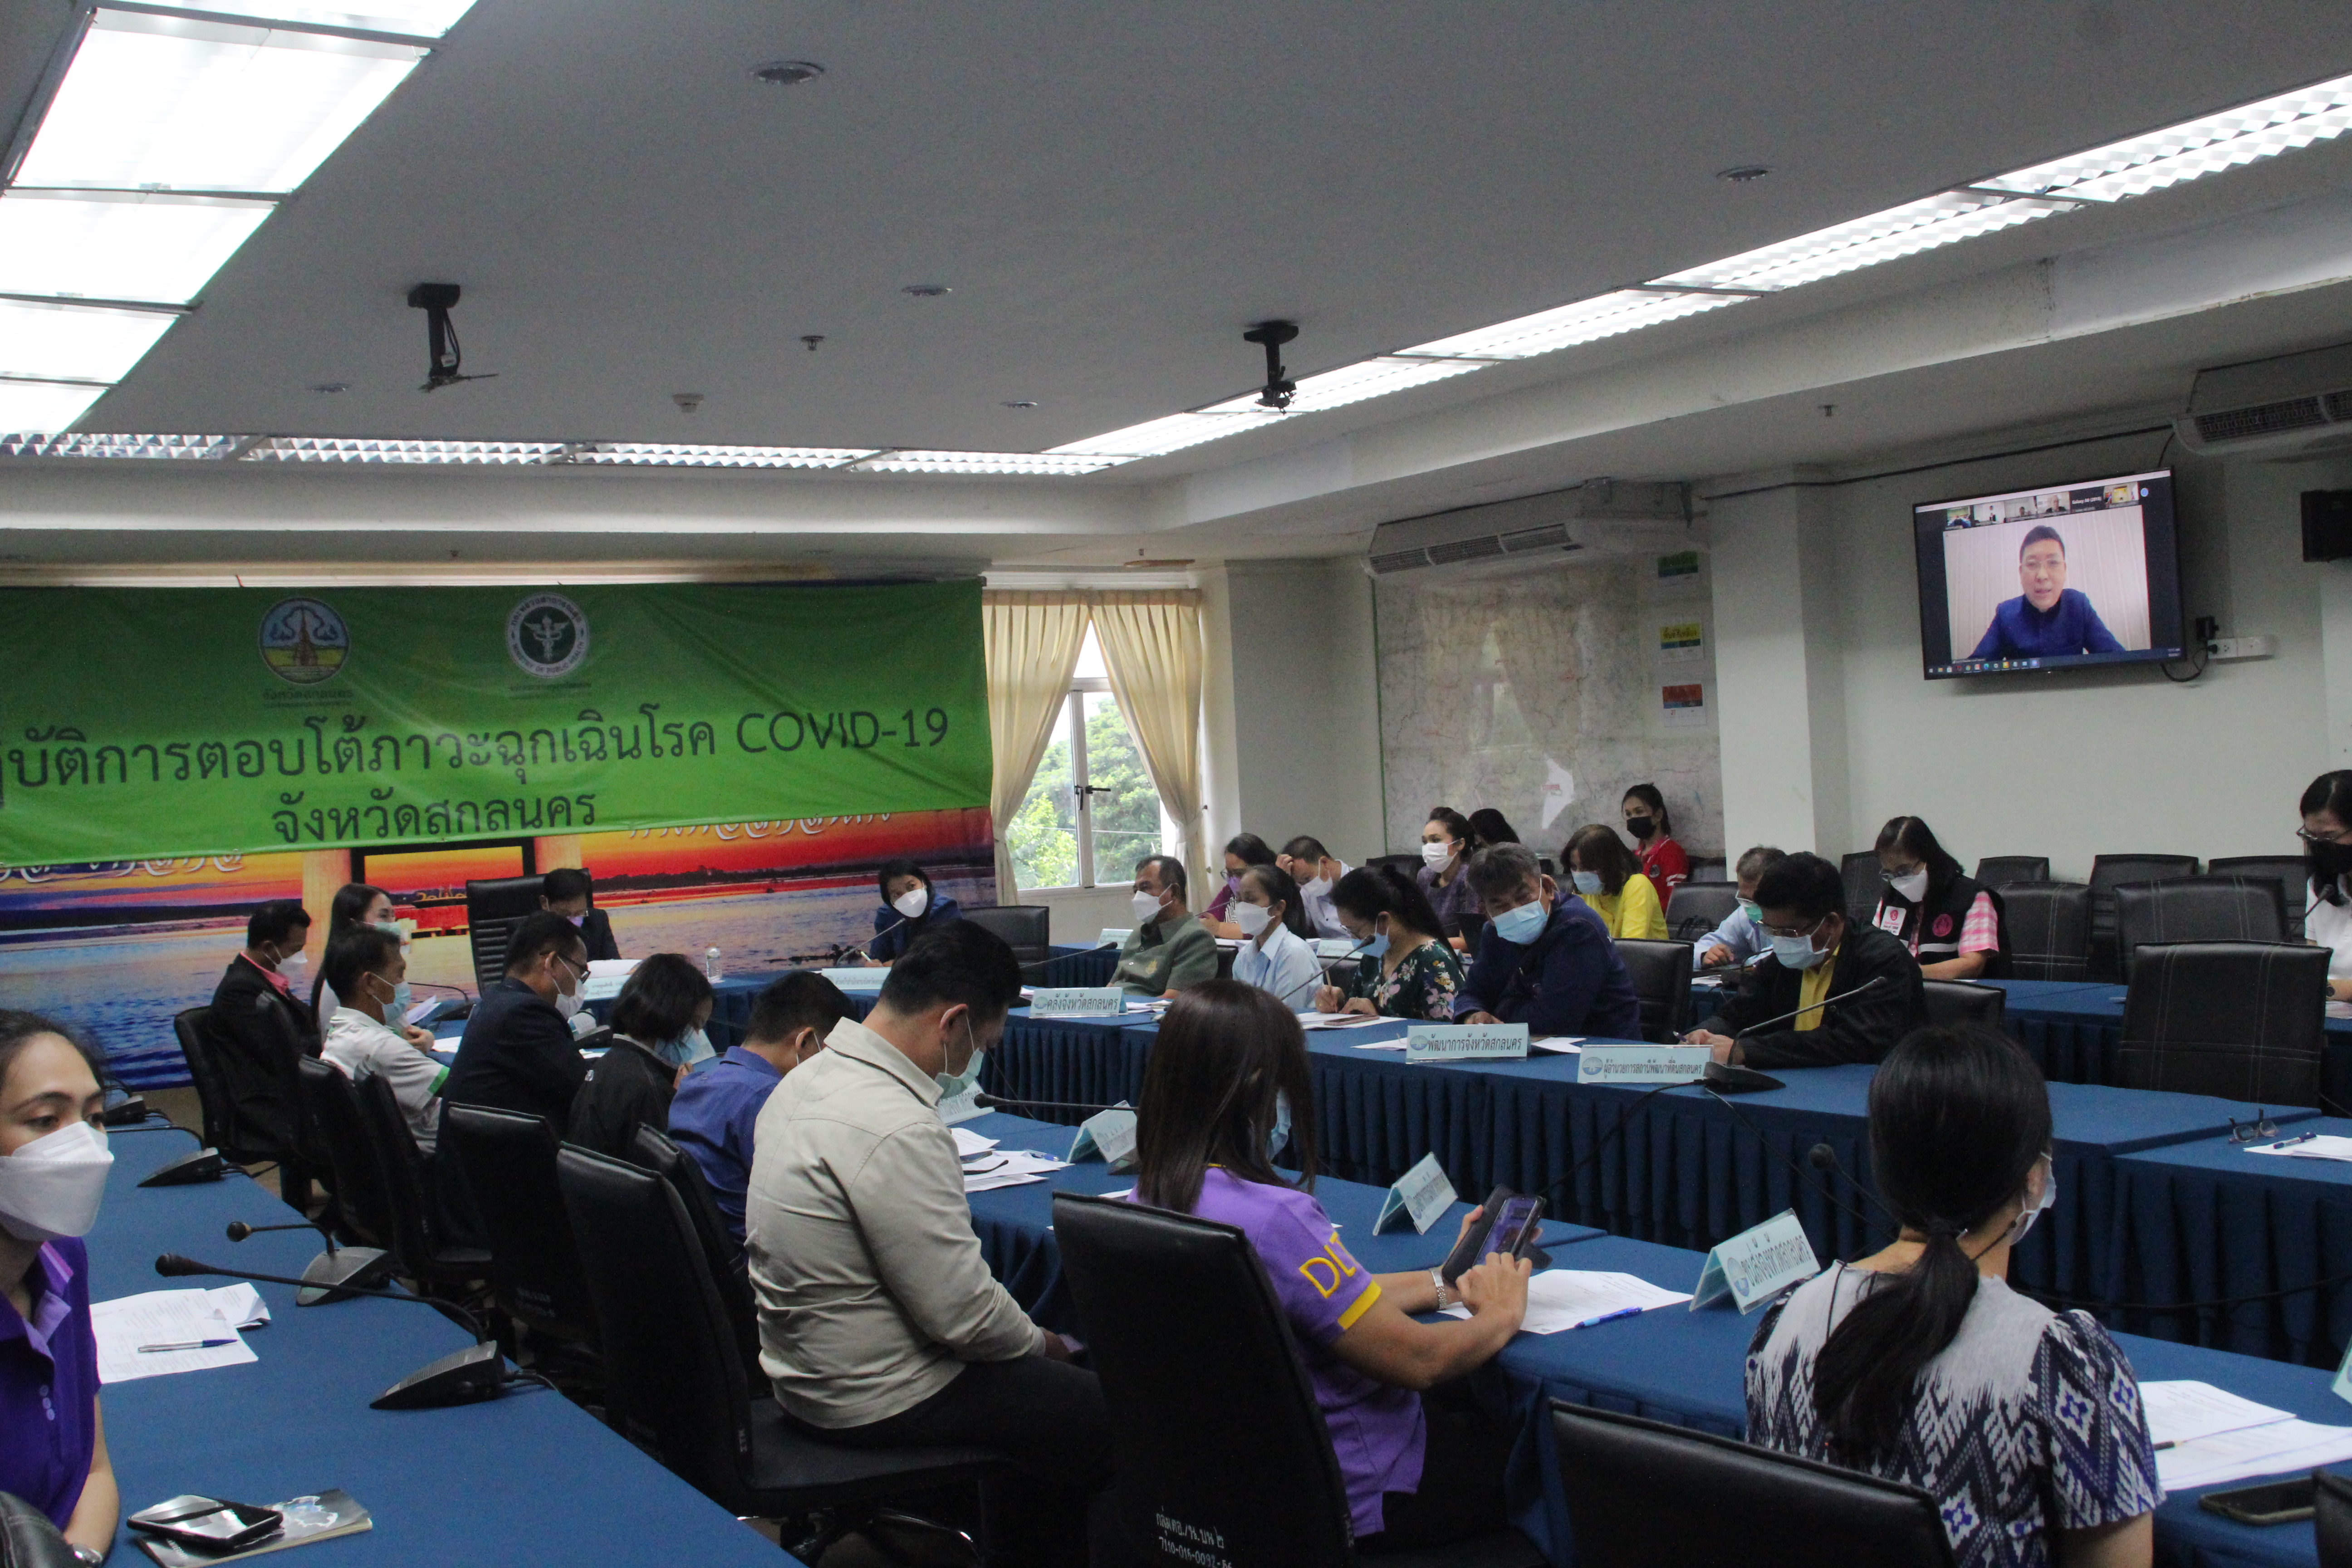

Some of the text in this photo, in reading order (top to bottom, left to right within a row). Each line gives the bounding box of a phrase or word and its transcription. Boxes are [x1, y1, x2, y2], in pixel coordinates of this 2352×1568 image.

[0, 703, 949, 808] บัติการตอบโต้ภาวะฉุกเฉินโรค COVID-19
[272, 786, 596, 843] จังหวัดสกลนคร
[1047, 992, 1118, 1011] คลังจังหวัดสกลนคร
[1428, 1033, 1522, 1052] พัฒนาการจังหวัดสกลนคร
[1604, 1056, 1702, 1079] ผู้อำนวยการสถานีพัฒนาที่ดินสกลนคร
